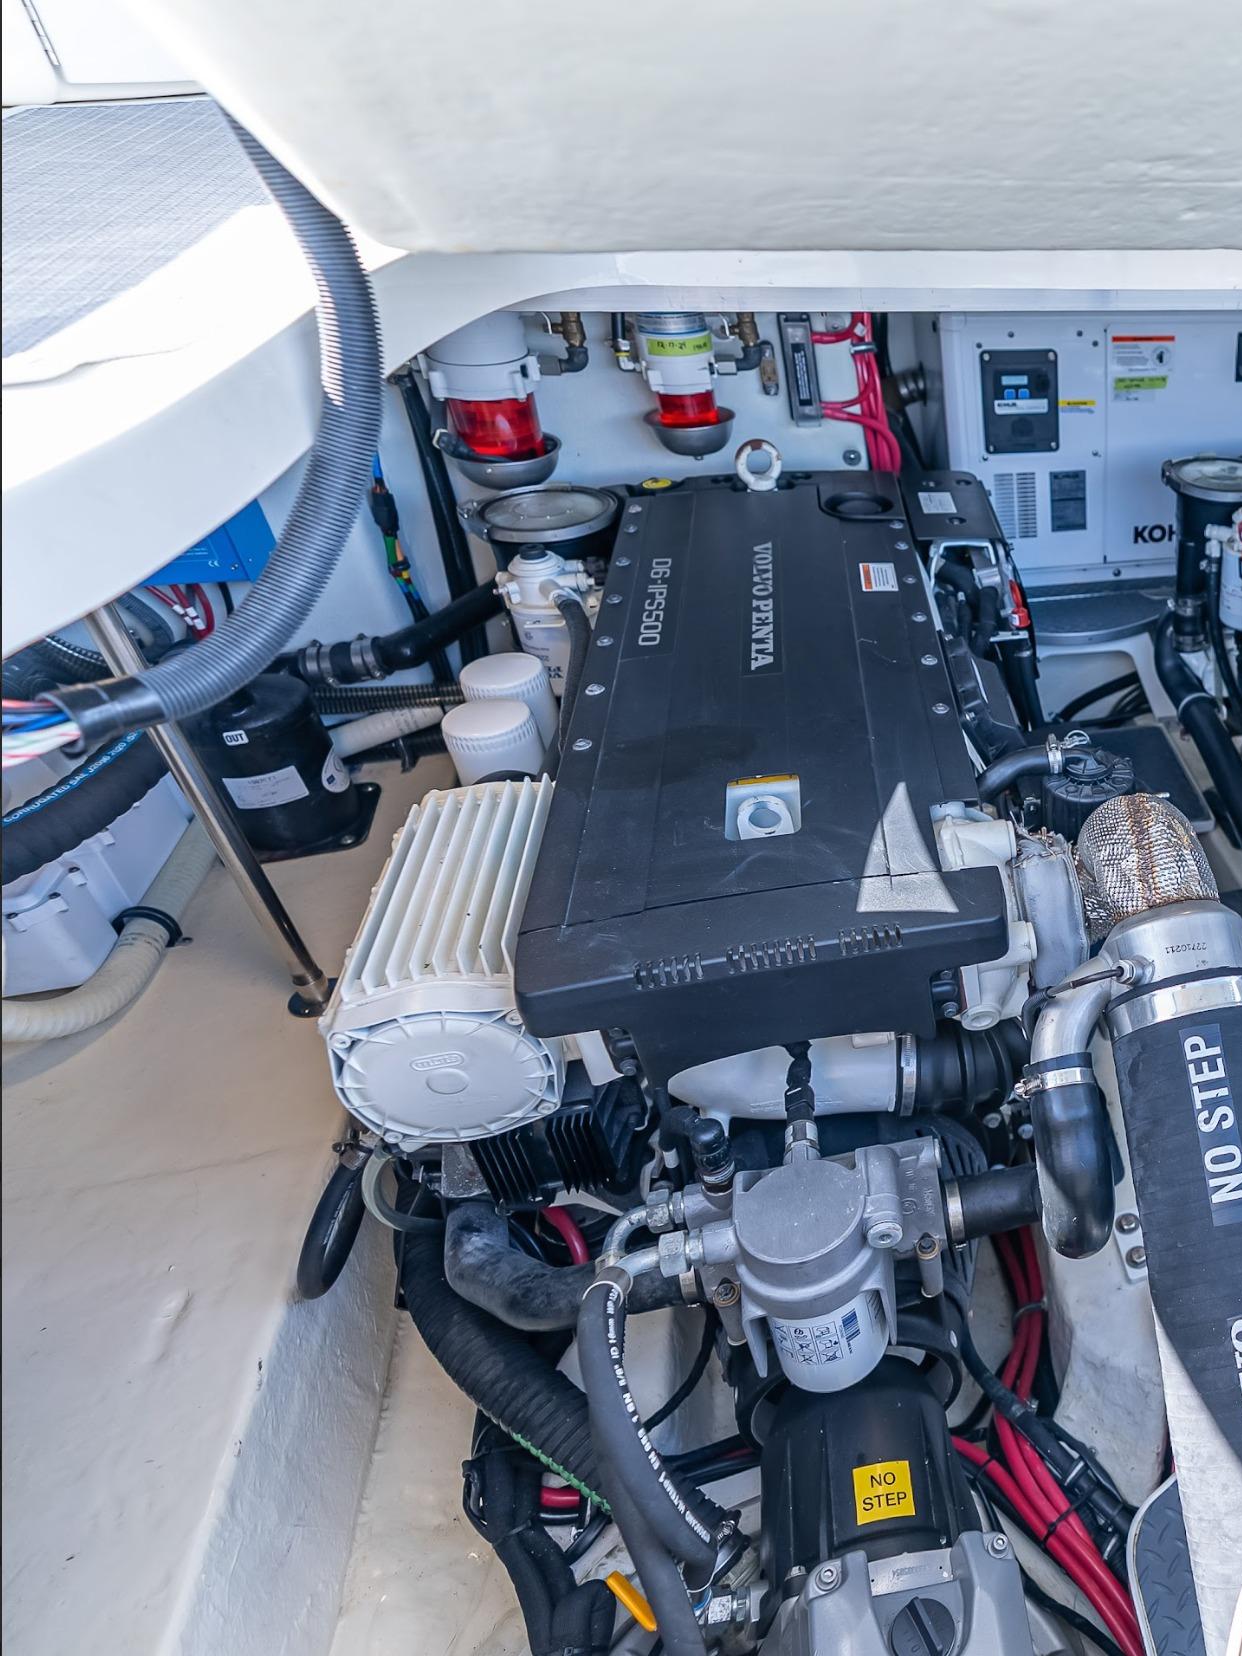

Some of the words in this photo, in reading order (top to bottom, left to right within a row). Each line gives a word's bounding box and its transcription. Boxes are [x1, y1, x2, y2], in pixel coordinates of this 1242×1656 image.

[752, 541, 774, 597] VOLVO
[637, 557, 673, 647] D6-IPS500
[751, 598, 774, 671] PENTA
[225, 733, 245, 743] OUT
[1183, 1035, 1235, 1133] STEP
[862, 1491, 907, 1511] STEP
[870, 1472, 896, 1488] NO
